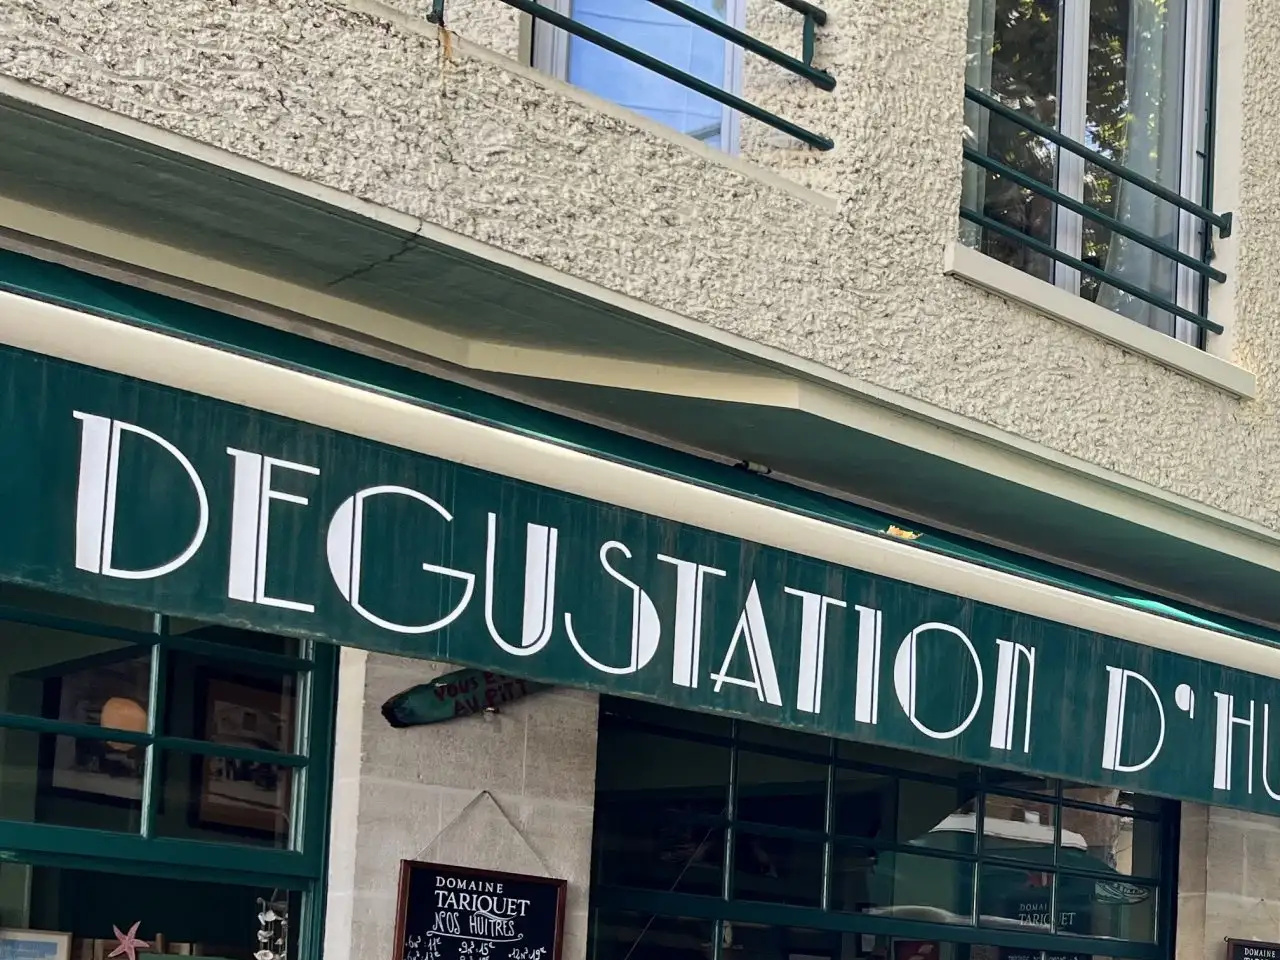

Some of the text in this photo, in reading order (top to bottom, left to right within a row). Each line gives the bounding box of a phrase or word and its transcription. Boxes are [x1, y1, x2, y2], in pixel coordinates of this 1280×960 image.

[72, 410, 1037, 753] DEGUSTATION
[435, 876, 504, 894] DOMAINE
[434, 890, 531, 920] TARIQUET
[432, 911, 515, 937] NOS HUITRES
[1244, 947, 1275, 958] DOMAINE
